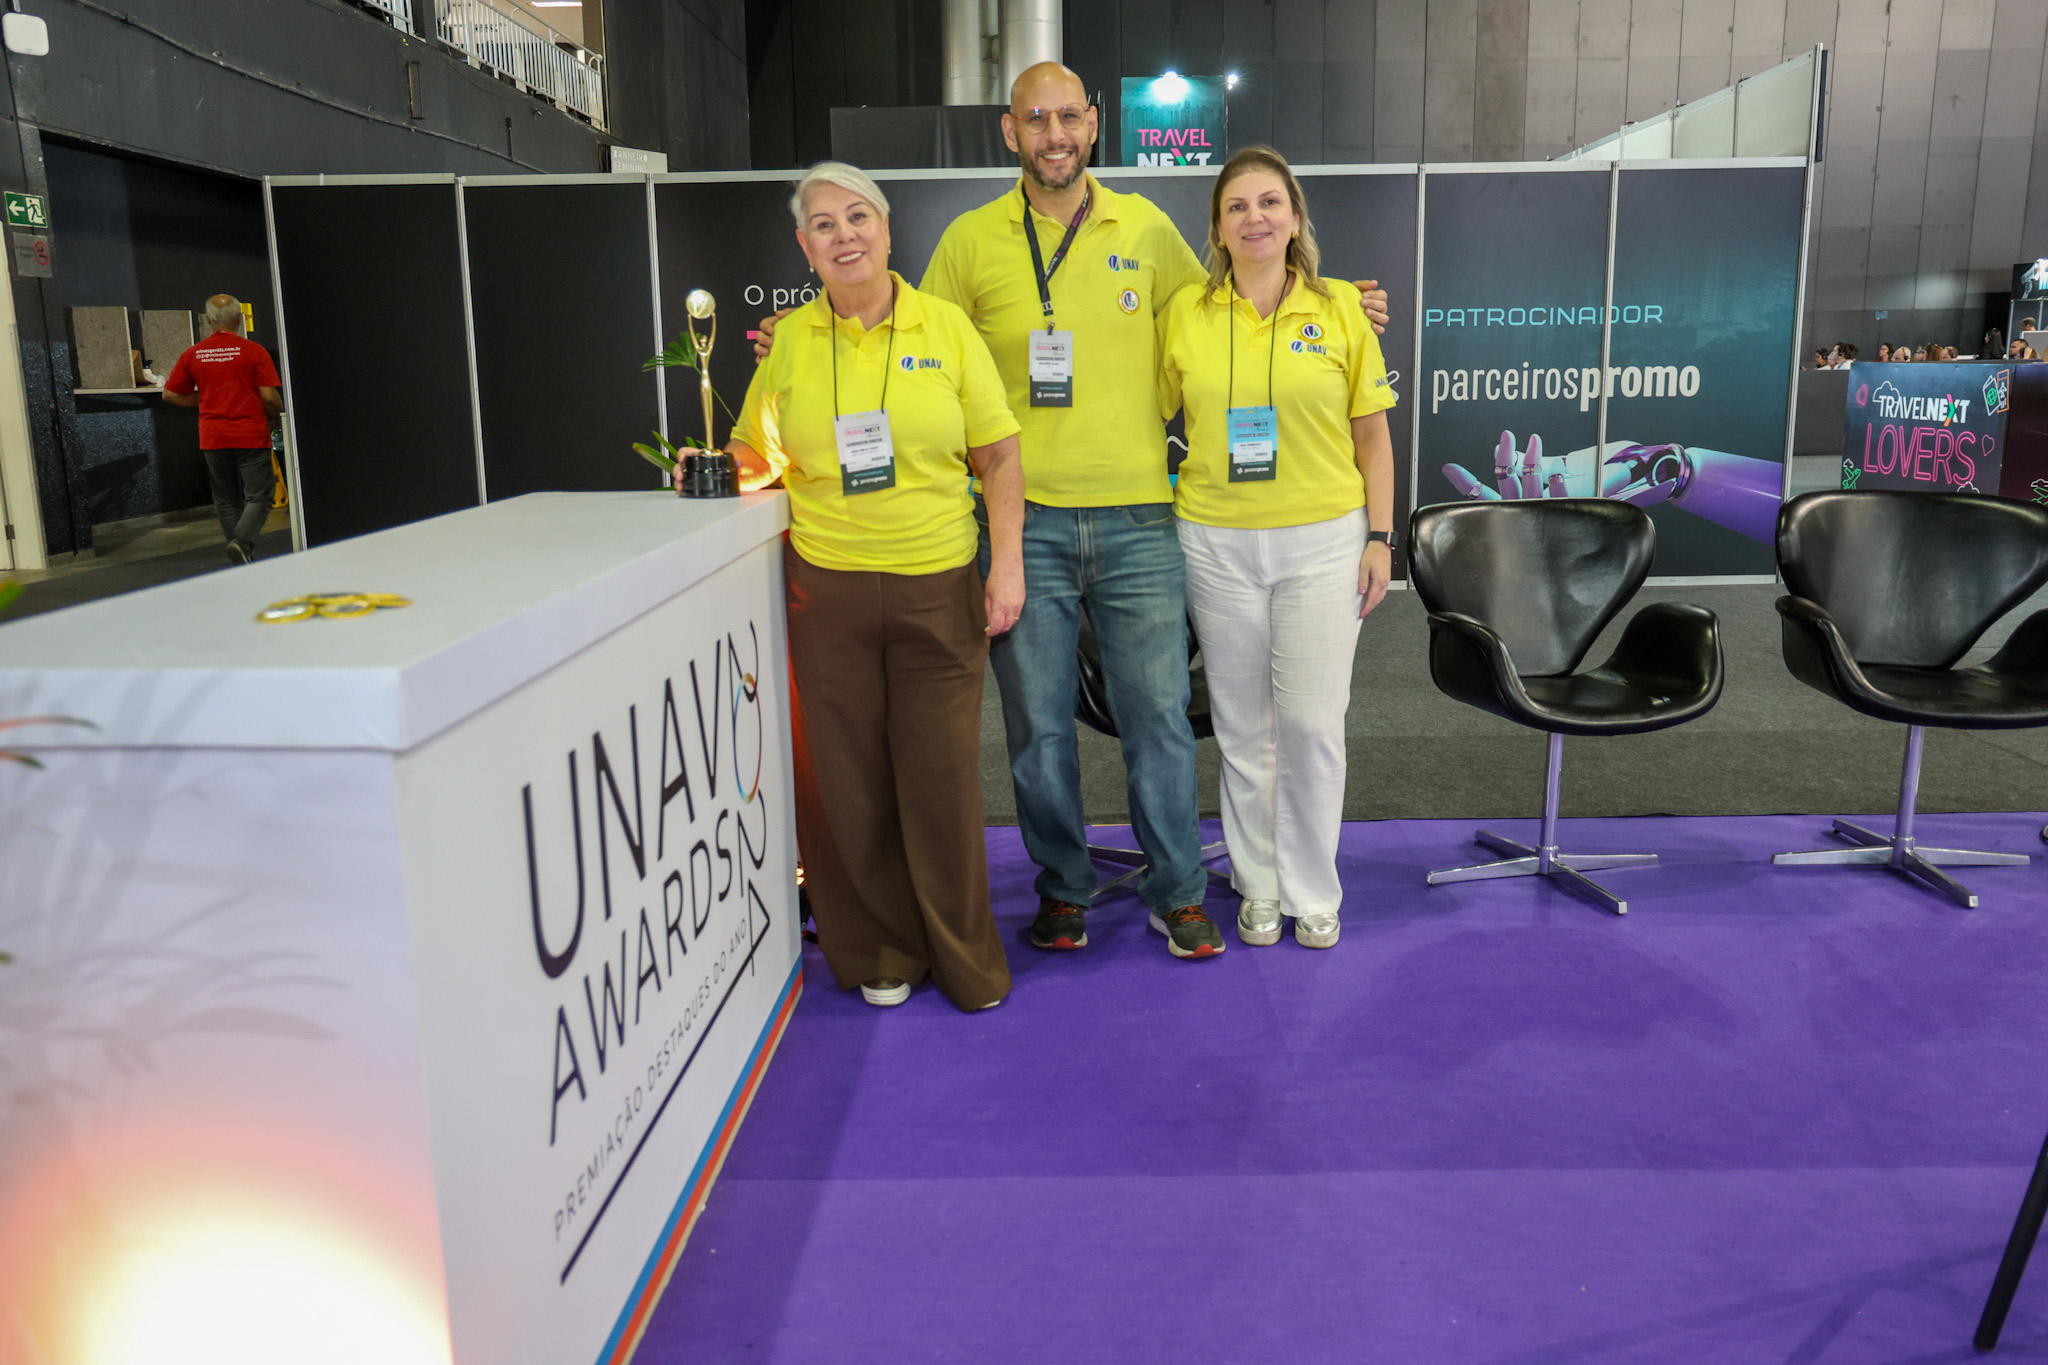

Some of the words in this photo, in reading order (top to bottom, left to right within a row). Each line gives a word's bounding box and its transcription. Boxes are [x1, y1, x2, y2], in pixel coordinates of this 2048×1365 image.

[1137, 128, 1213, 147] TRAVEL
[1122, 258, 1140, 271] UNAV
[744, 284, 765, 306] O
[772, 282, 822, 313] pró
[1425, 305, 1664, 328] PATROCINADOR
[918, 357, 942, 369] UNAV
[1306, 343, 1328, 356] UNAV
[1432, 361, 1700, 415] parceirospromo
[1878, 394, 1971, 427] TRAVELNEXT
[1864, 422, 1977, 486] LOVERS
[521, 637, 721, 979] UNAV
[549, 808, 733, 1148] AWARDS
[553, 1084, 644, 1243] PREMIAÇÃO
[647, 974, 711, 1093] DESTAQUES
[712, 949, 727, 986] DO
[729, 917, 748, 959] ANO
